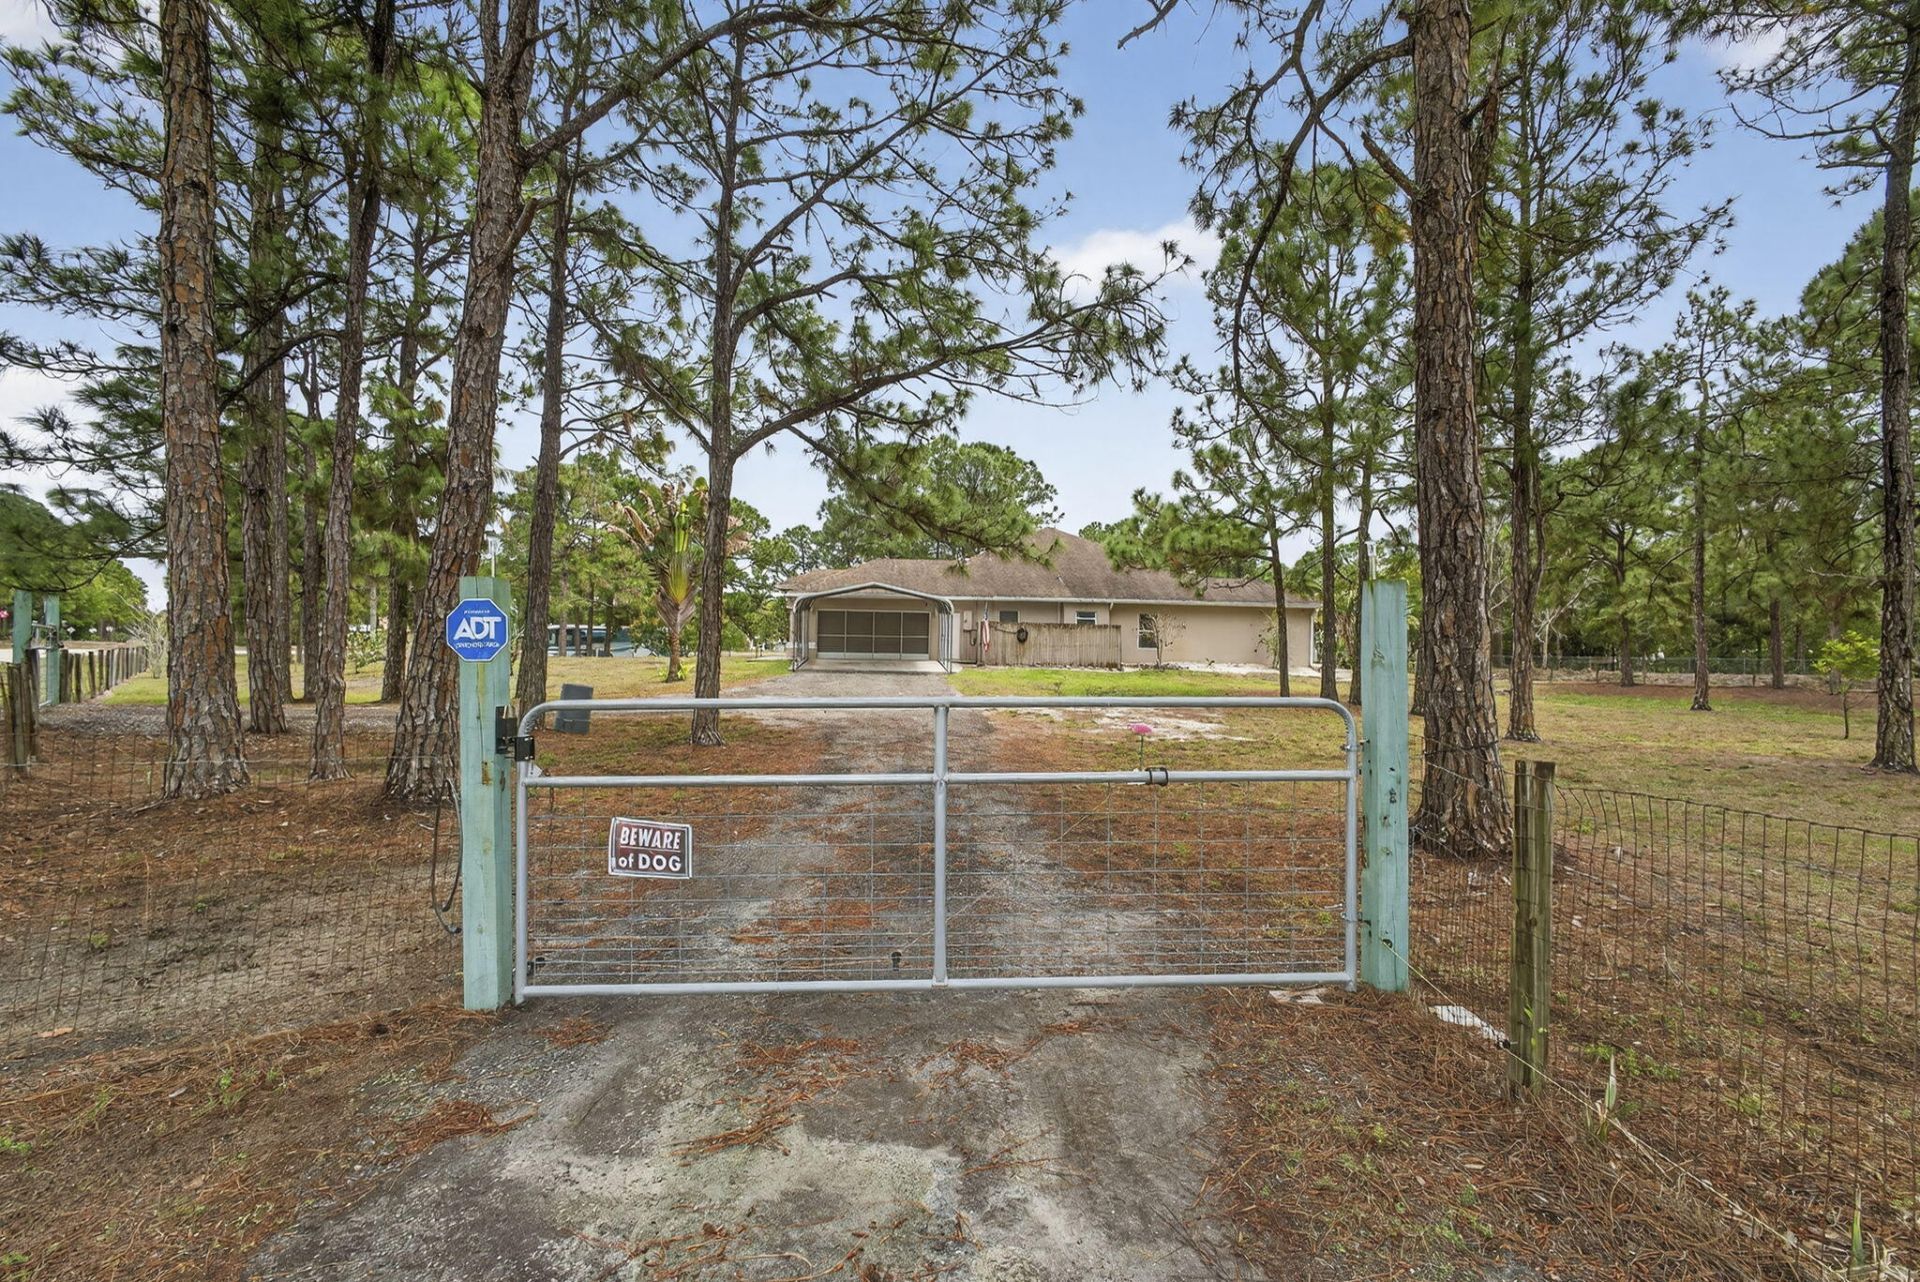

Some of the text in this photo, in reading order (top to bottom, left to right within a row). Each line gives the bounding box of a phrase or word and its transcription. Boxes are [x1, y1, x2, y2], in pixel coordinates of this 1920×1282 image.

[453, 616, 502, 640] ADT
[620, 826, 681, 850] BEWARE
[618, 853, 682, 872] of DOG
